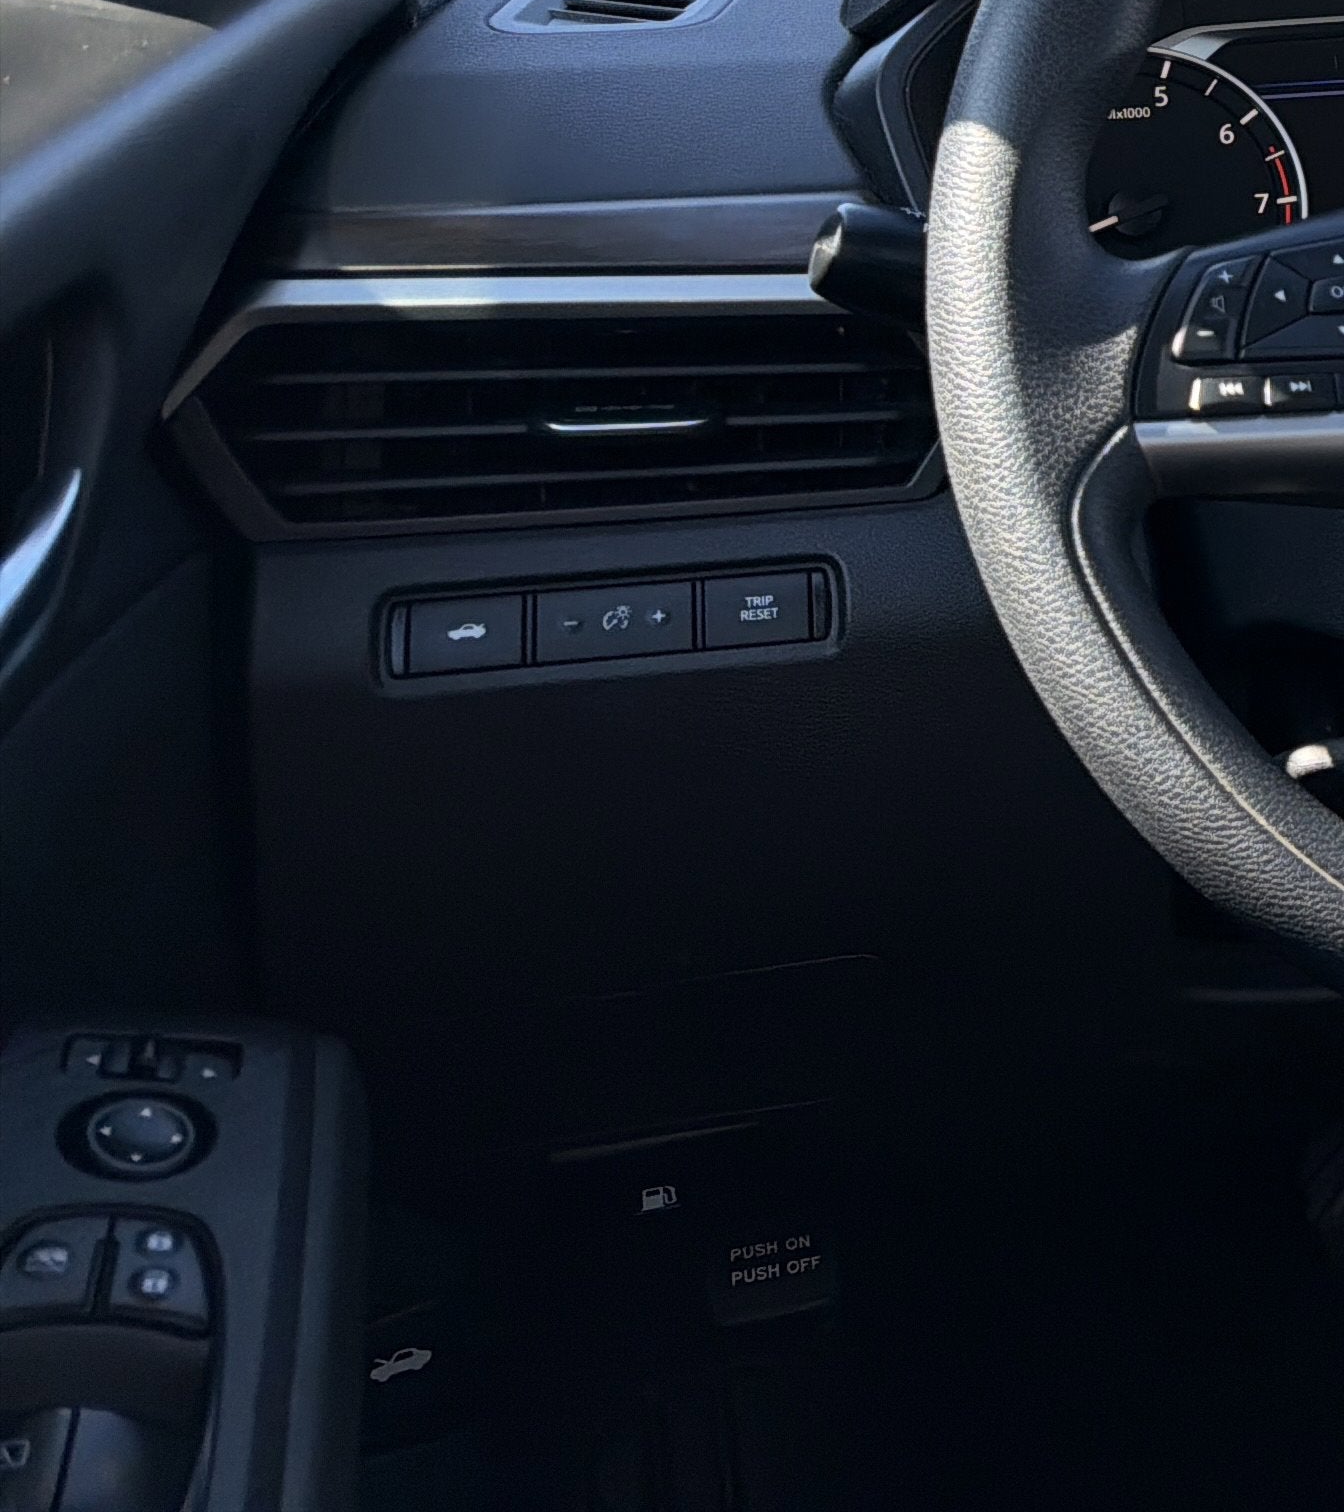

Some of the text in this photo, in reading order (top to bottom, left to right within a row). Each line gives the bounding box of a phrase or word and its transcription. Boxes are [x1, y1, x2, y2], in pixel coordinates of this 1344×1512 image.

[1154, 86, 1169, 107] 5
[1219, 124, 1235, 145] 6
[1254, 193, 1269, 214] 7
[745, 595, 774, 607] TRIP
[740, 607, 779, 621] RESET
[729, 1235, 811, 1263] PUSH ON
[731, 1255, 822, 1287] PUSH OFF
